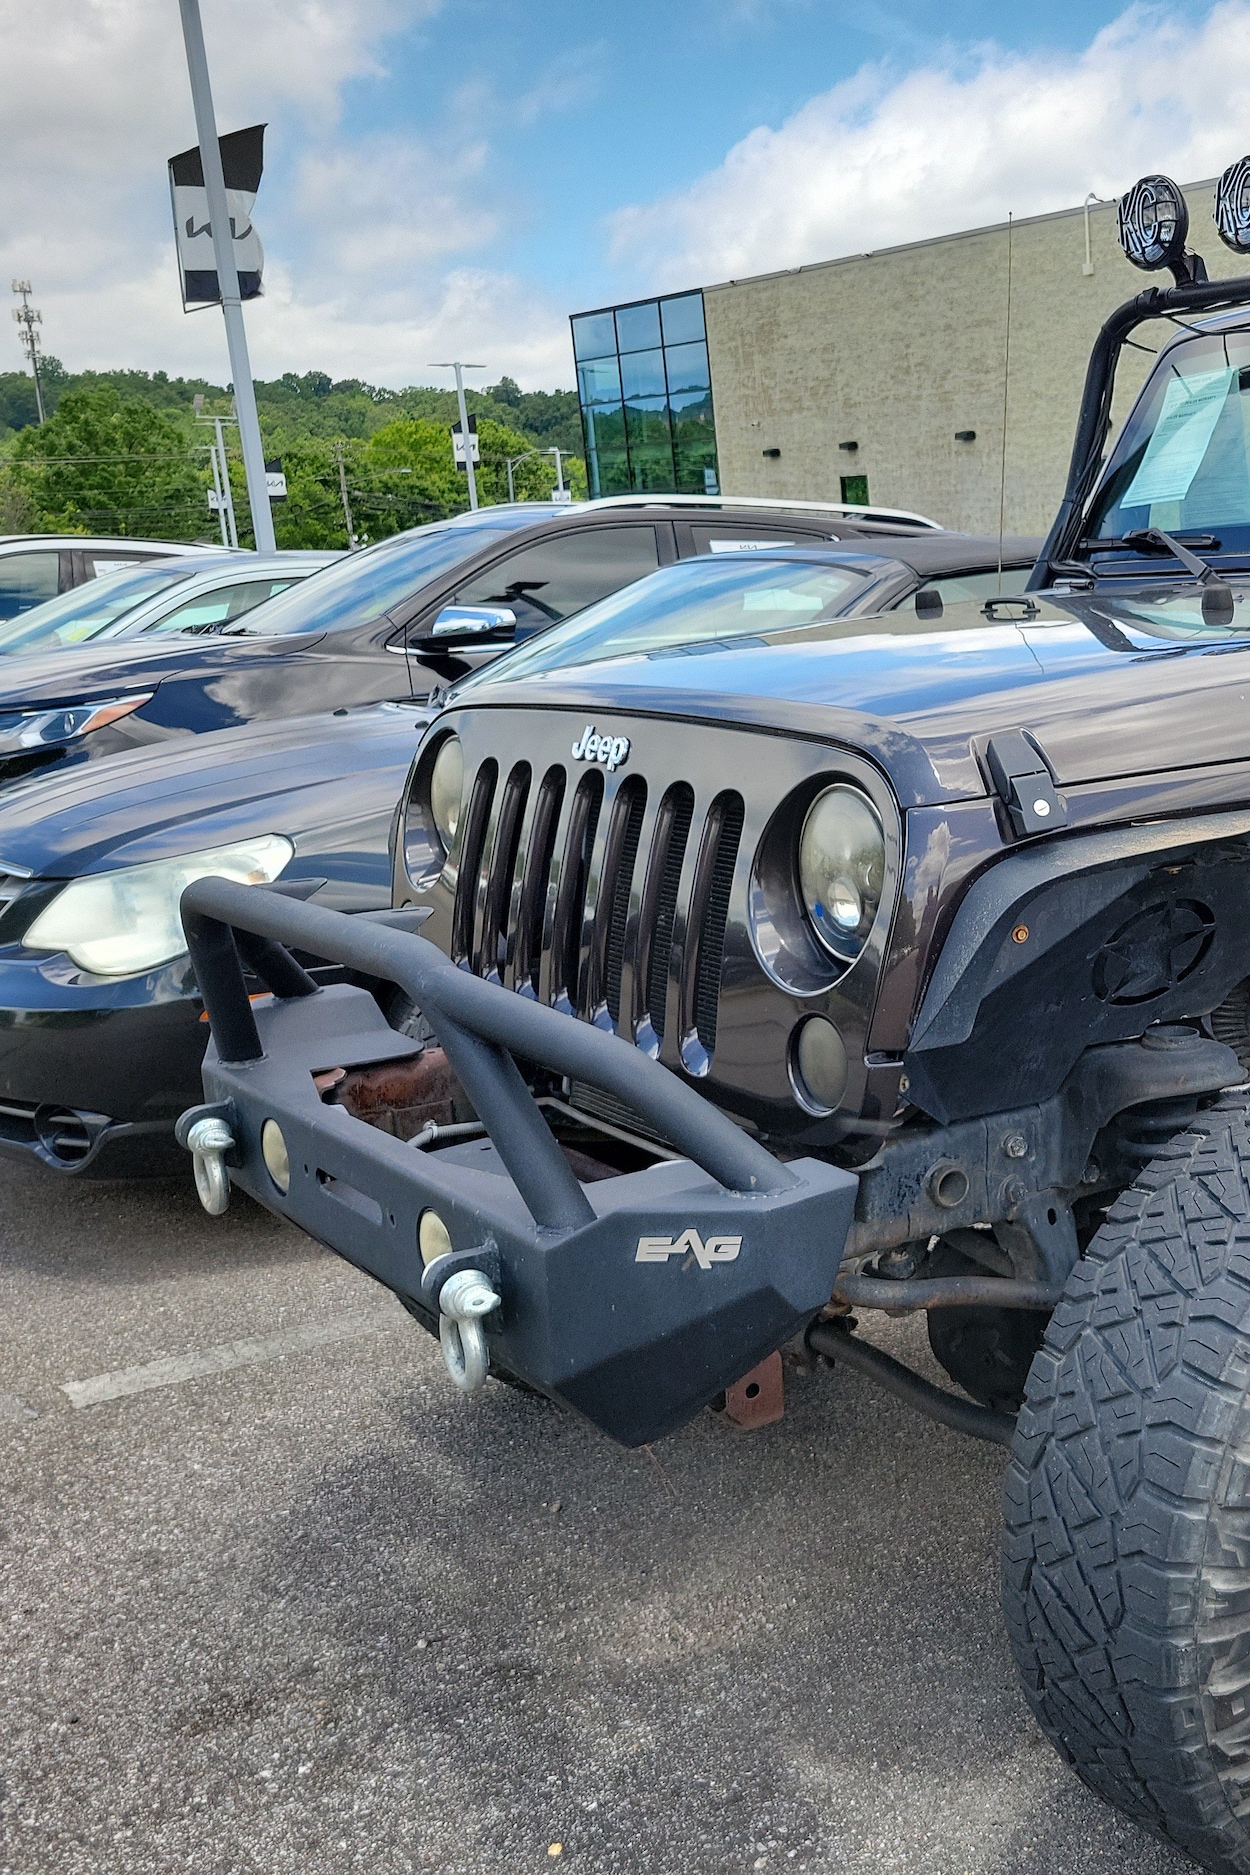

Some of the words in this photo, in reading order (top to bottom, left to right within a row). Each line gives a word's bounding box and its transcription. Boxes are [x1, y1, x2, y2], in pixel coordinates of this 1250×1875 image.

[1117, 185, 1157, 254] KC
[572, 725, 629, 772] Jeep
[635, 1228, 742, 1270] EAG
